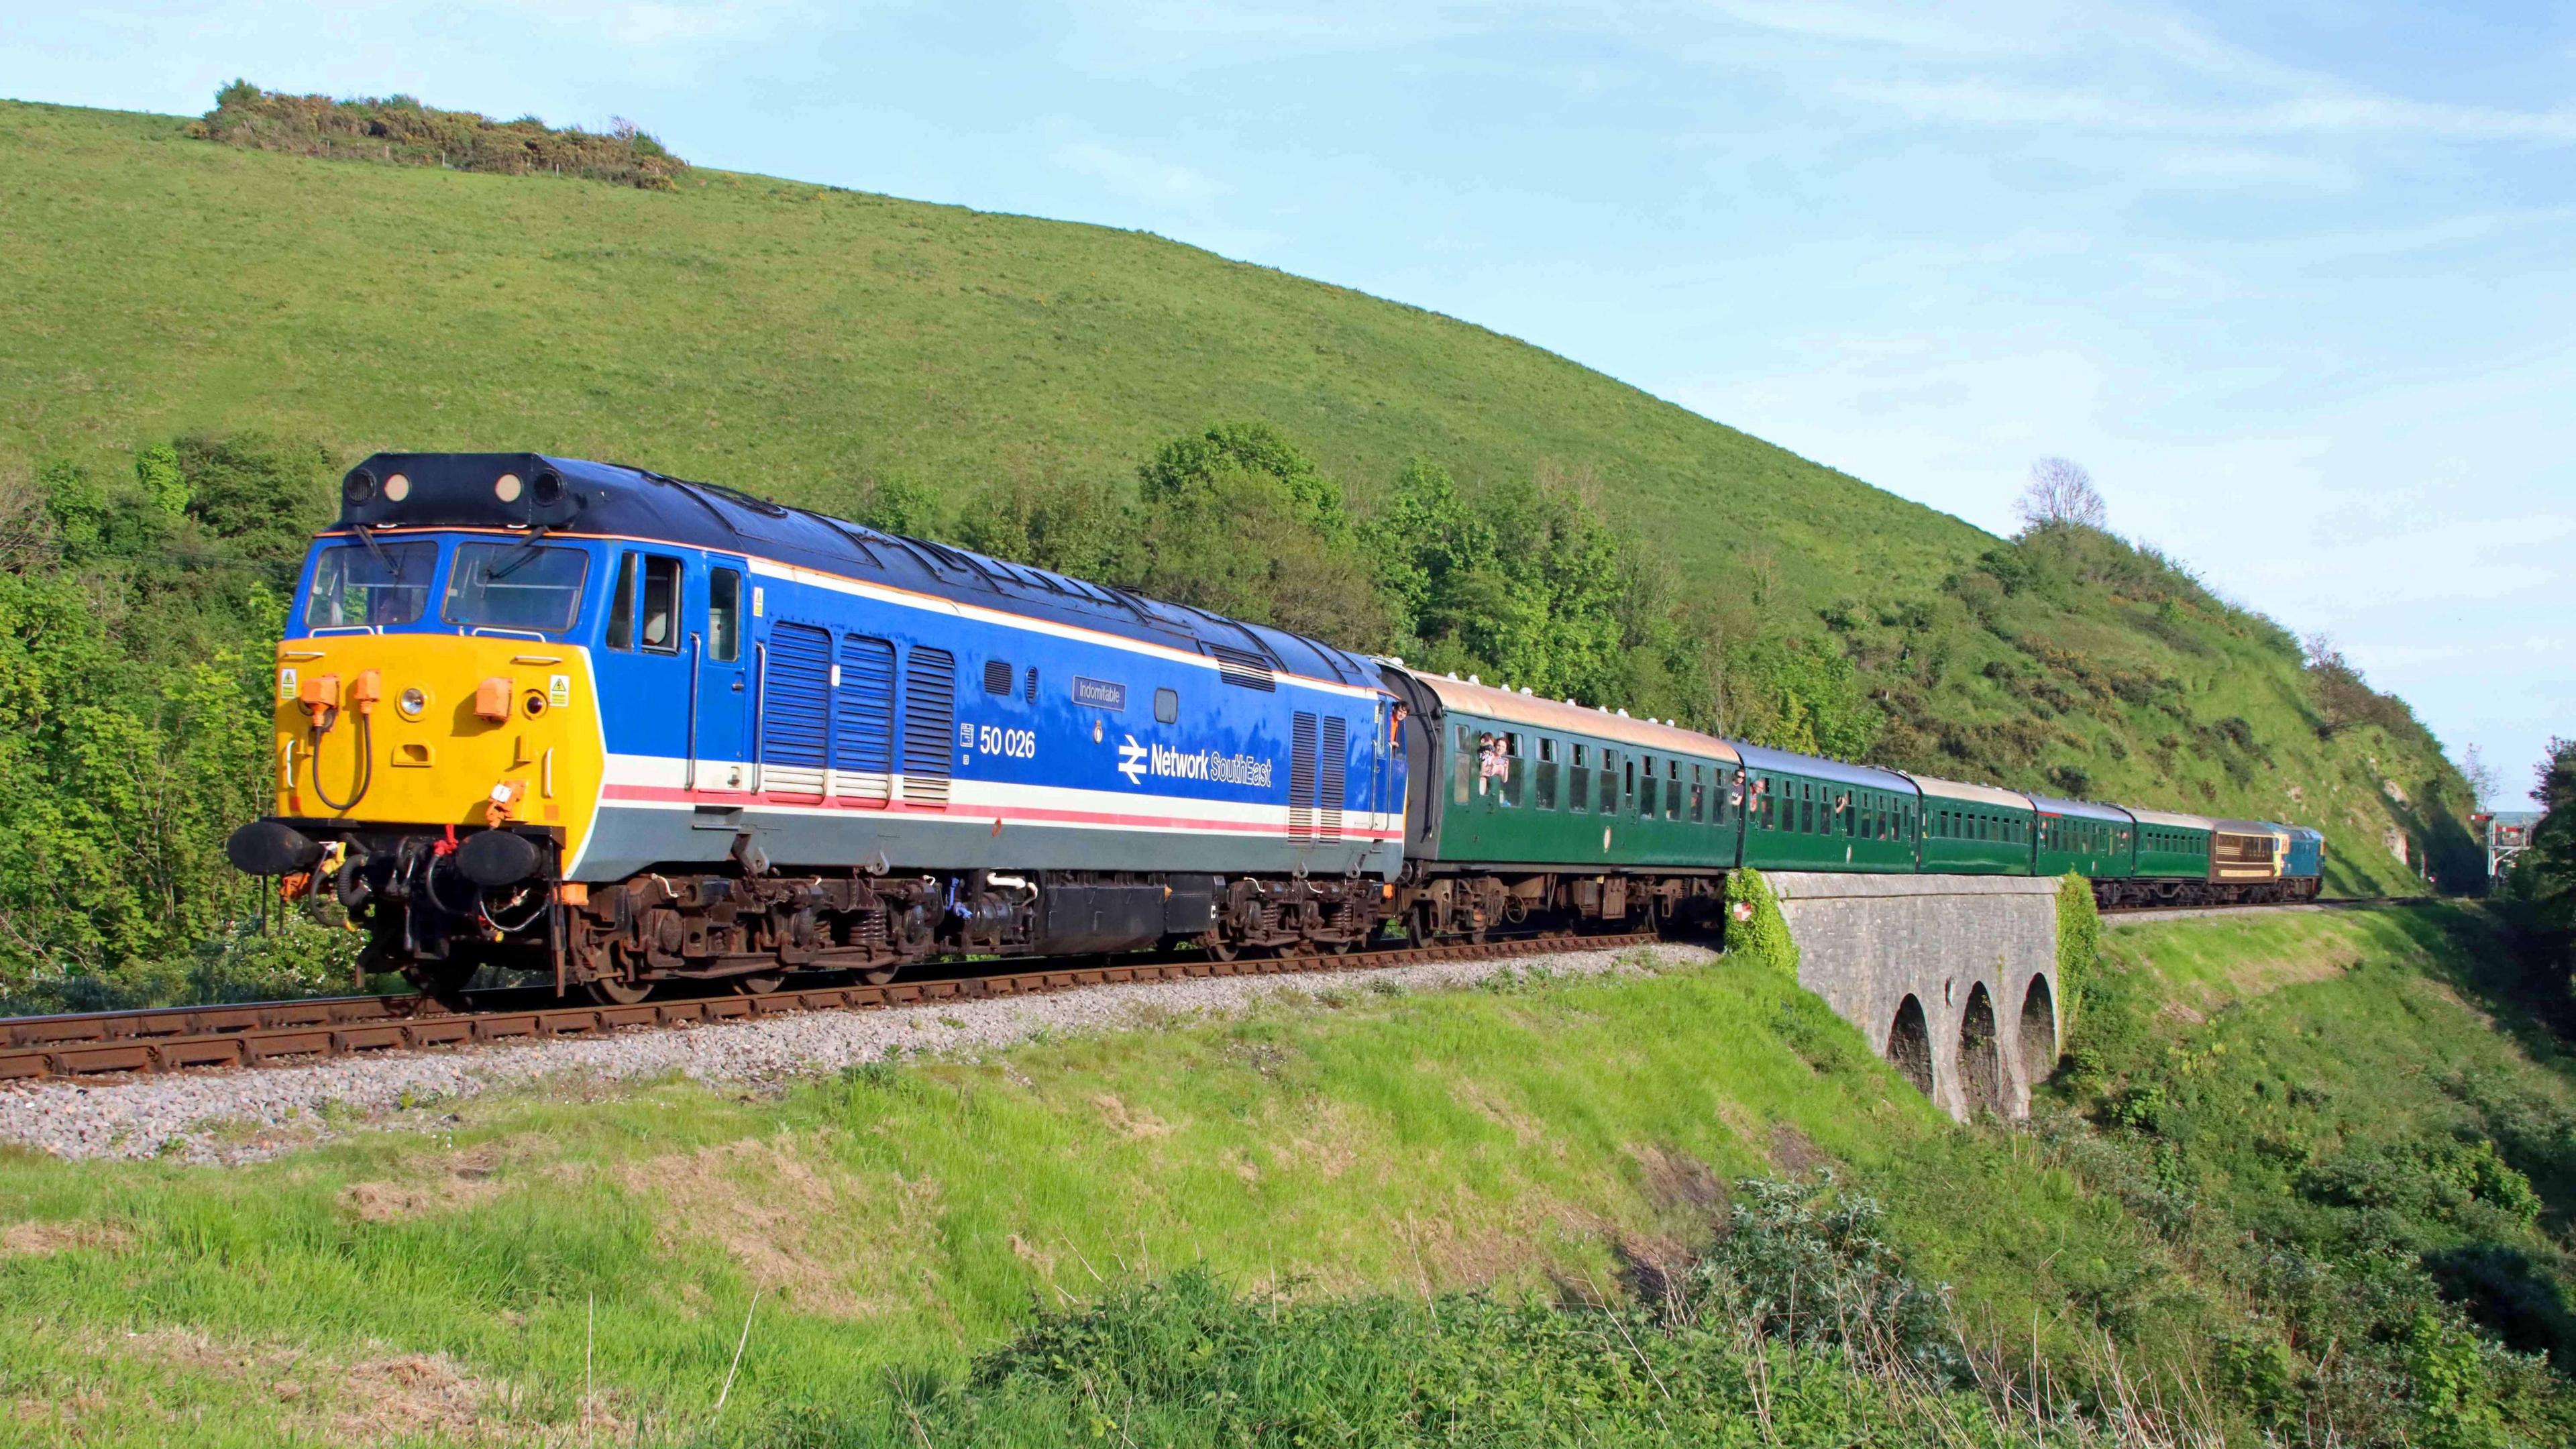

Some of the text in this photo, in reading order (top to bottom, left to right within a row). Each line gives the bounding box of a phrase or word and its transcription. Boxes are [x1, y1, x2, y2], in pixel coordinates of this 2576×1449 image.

[1079, 681, 1120, 704] Indomitable
[979, 725, 1002, 755] 50
[1005, 728, 1036, 759] 026
[1150, 743, 1273, 788] Network SouthEast
